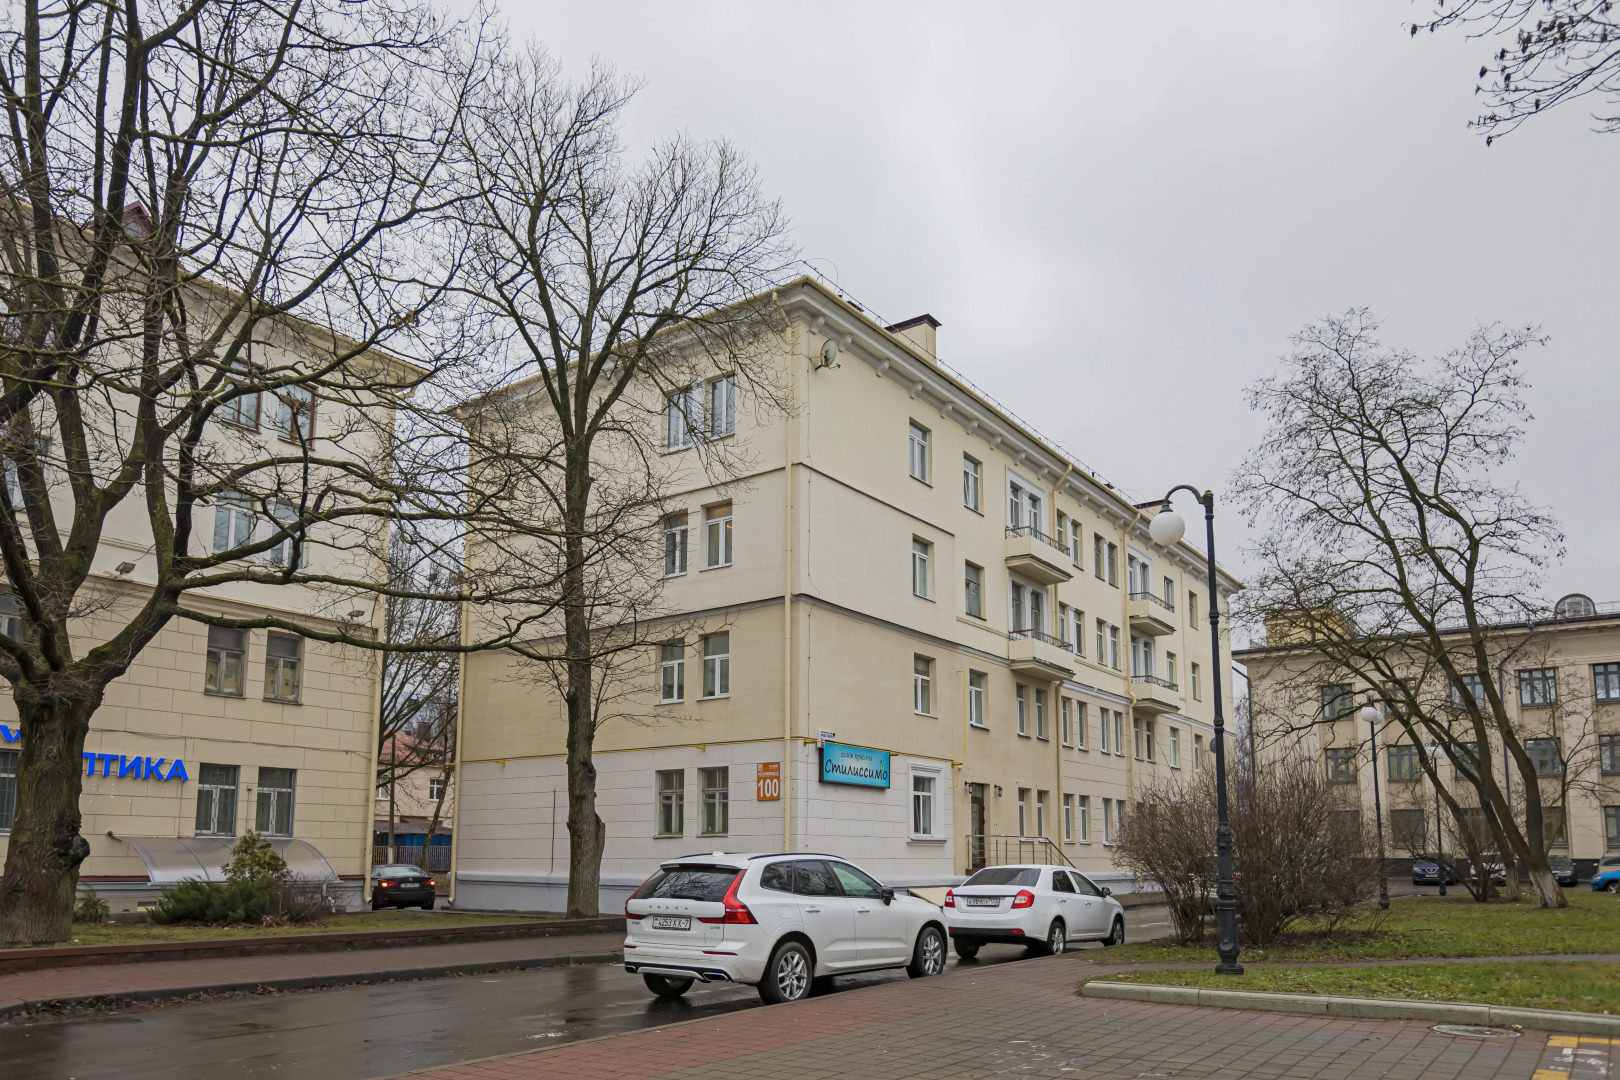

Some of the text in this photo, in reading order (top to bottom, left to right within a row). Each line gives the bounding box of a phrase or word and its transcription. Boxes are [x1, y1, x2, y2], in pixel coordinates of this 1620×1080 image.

[82, 752, 189, 781] ПТИКА
[824, 759, 888, 780] Стилиссимо
[758, 778, 779, 798] 100
